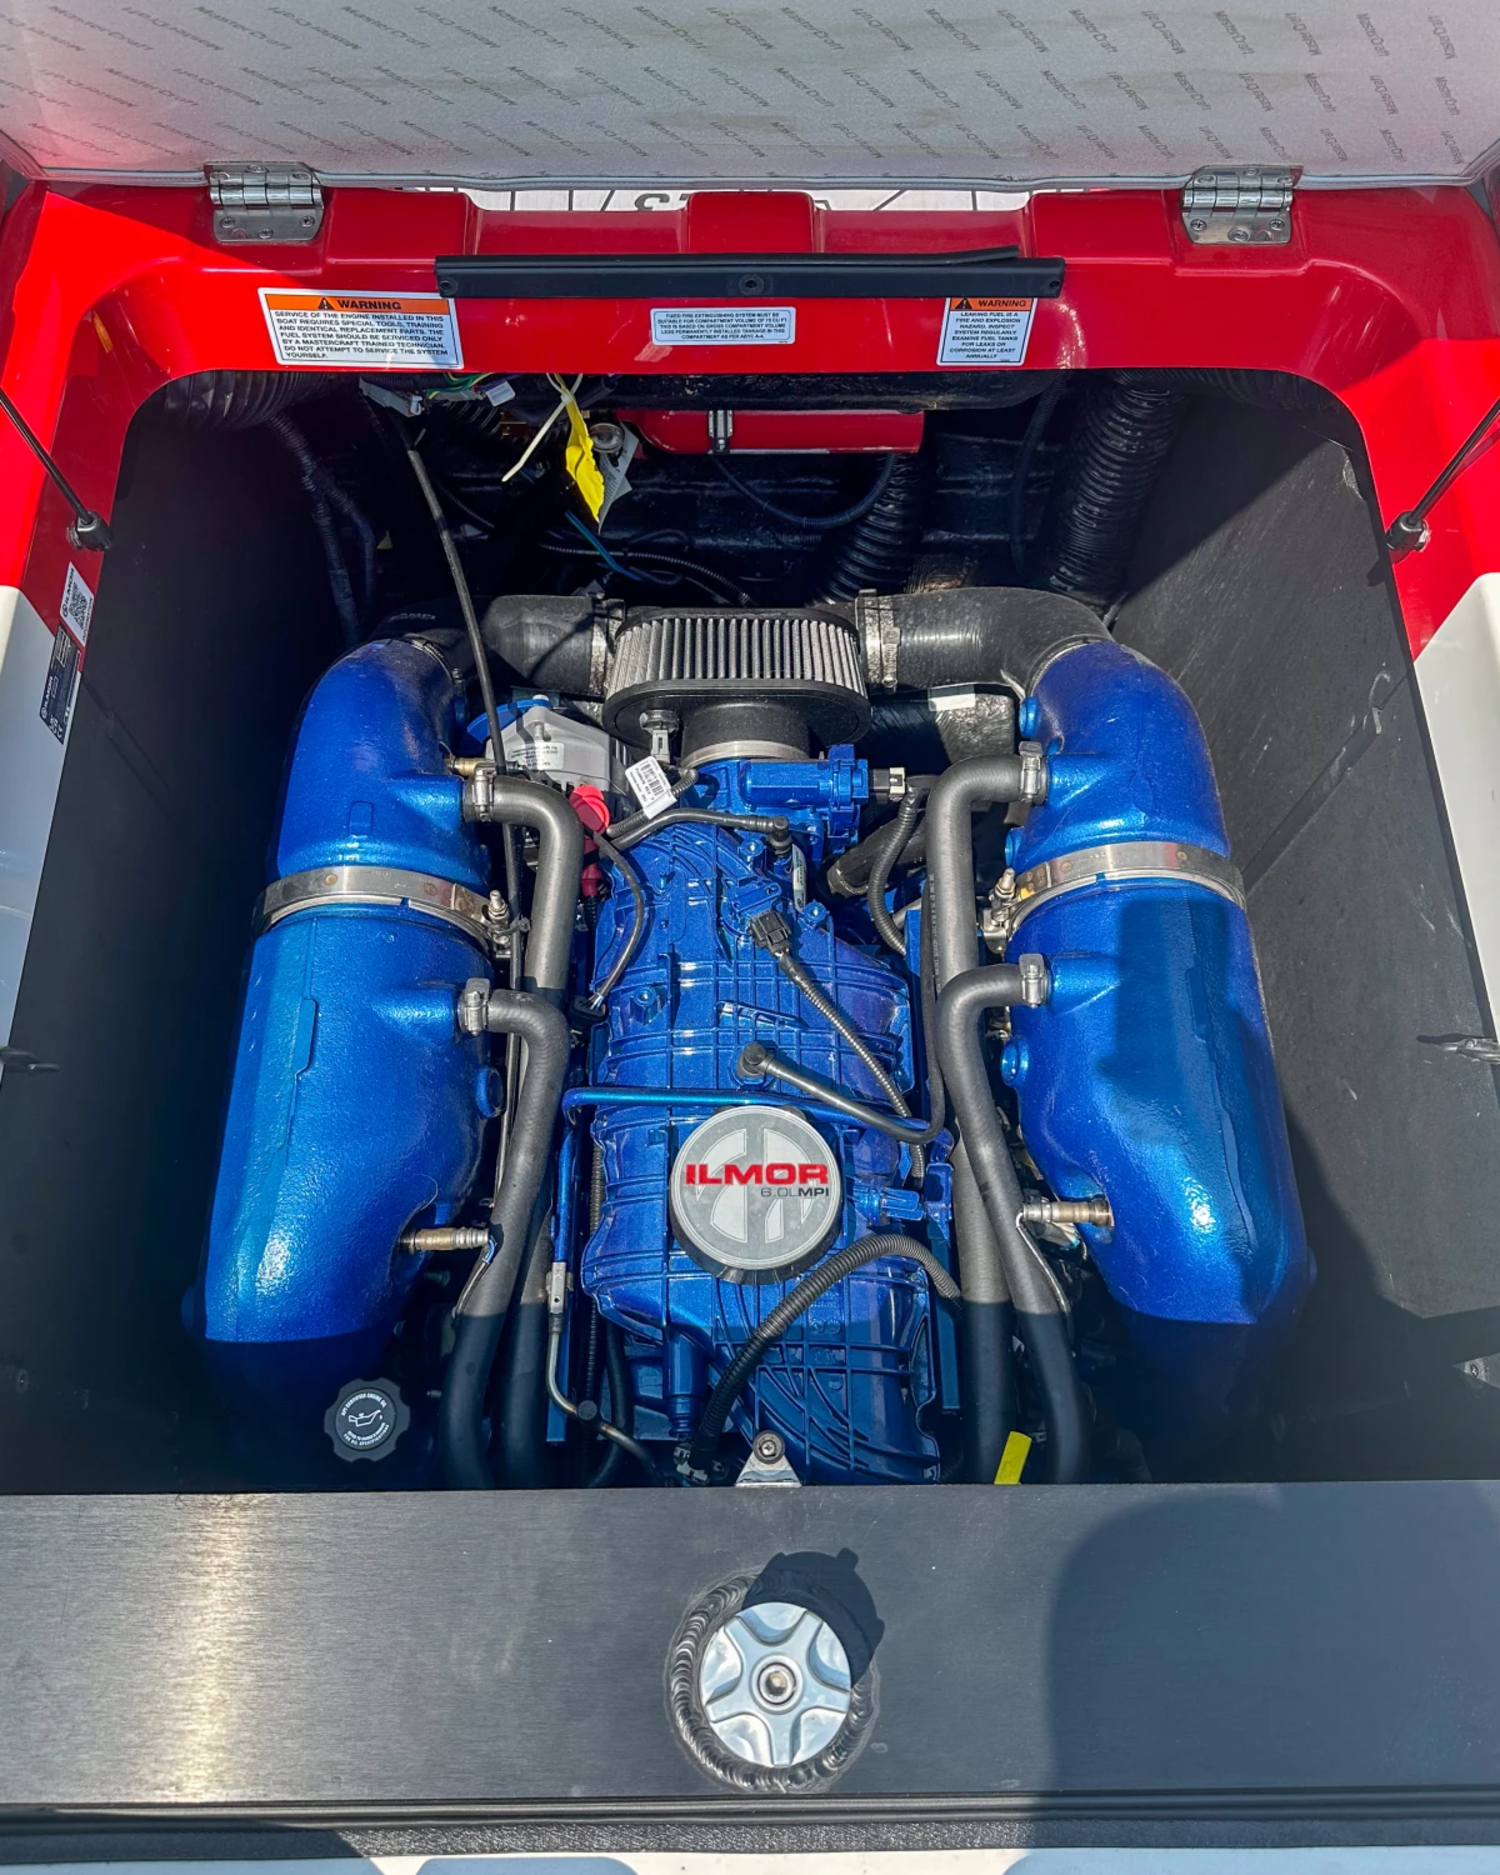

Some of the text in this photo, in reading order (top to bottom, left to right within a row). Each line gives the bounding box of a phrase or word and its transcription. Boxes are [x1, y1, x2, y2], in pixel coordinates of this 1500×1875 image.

[337, 300, 402, 310] WARNING
[978, 299, 1026, 307] WARNING
[685, 1163, 829, 1185] ILMOR
[760, 1187, 829, 1197] 6.0LMPI
